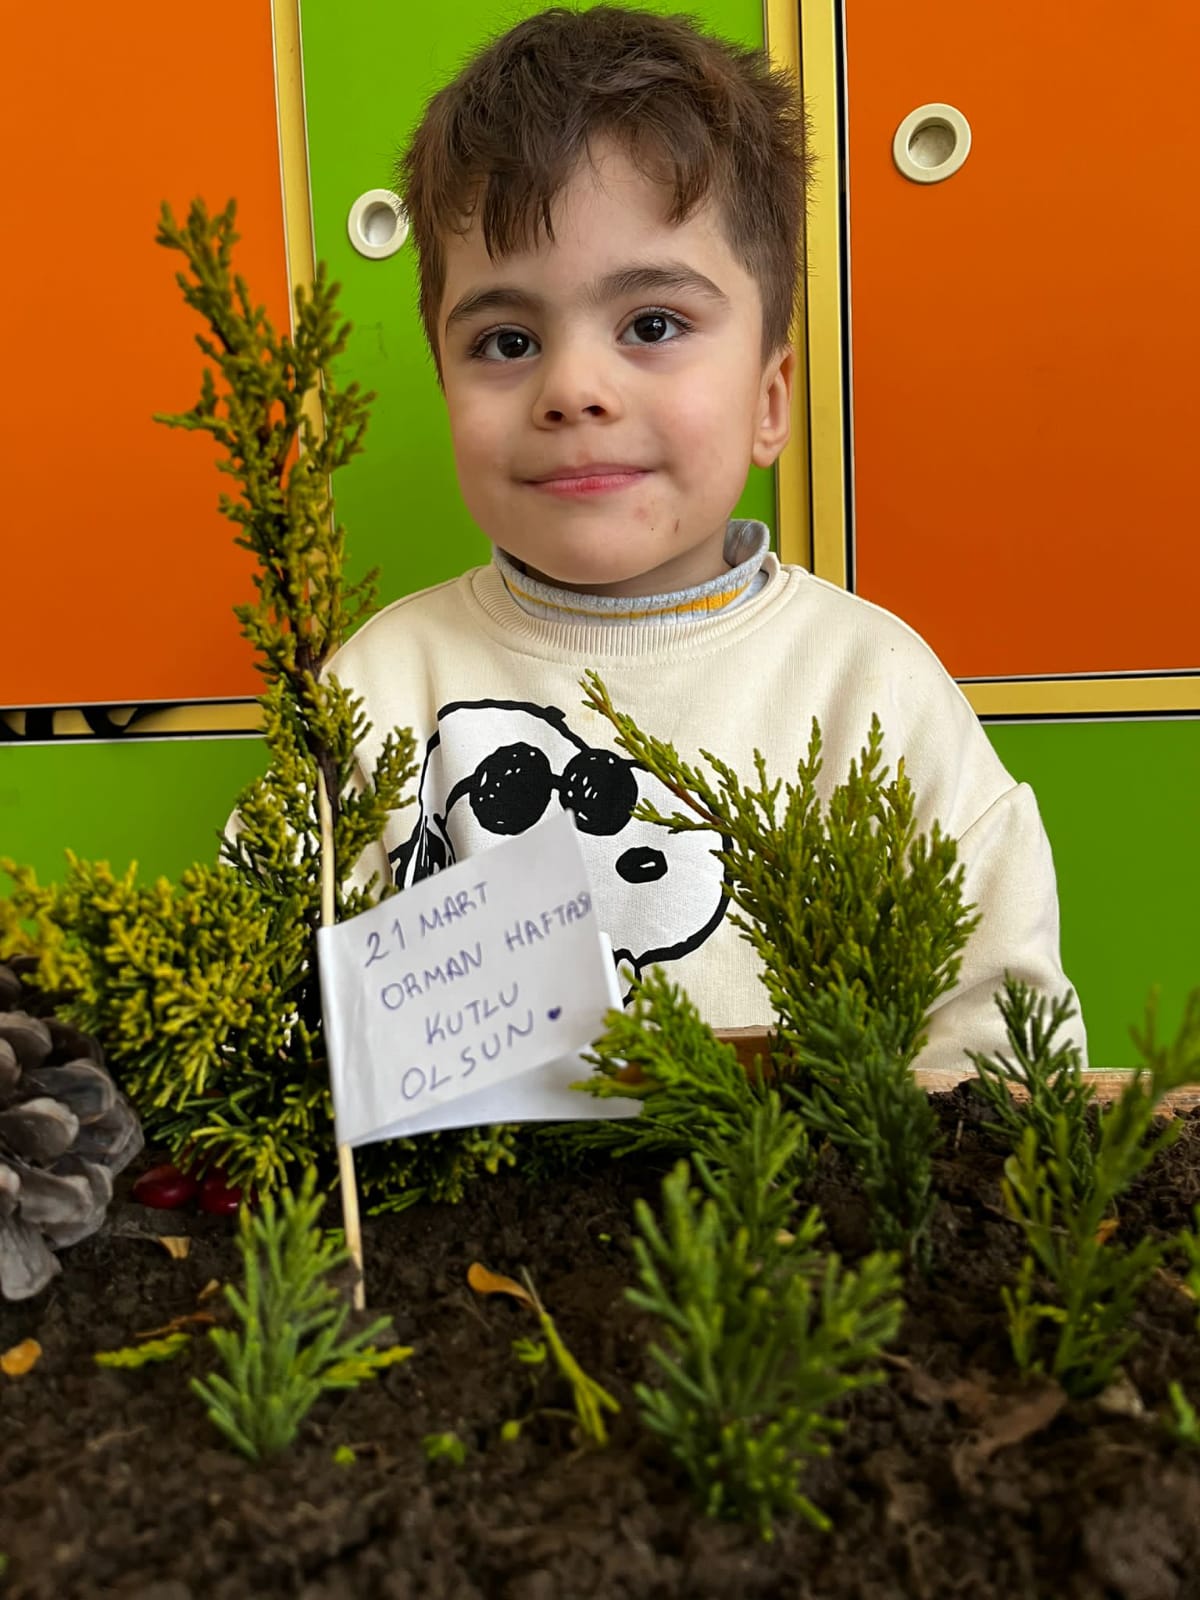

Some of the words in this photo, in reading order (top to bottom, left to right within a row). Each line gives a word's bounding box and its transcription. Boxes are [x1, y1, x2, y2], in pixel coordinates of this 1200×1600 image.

[365, 919, 405, 967] 21
[420, 881, 488, 938] MART
[380, 942, 483, 1011] ORMAN
[425, 982, 519, 1045] KUTLU
[401, 1009, 534, 1100] OLSUN
